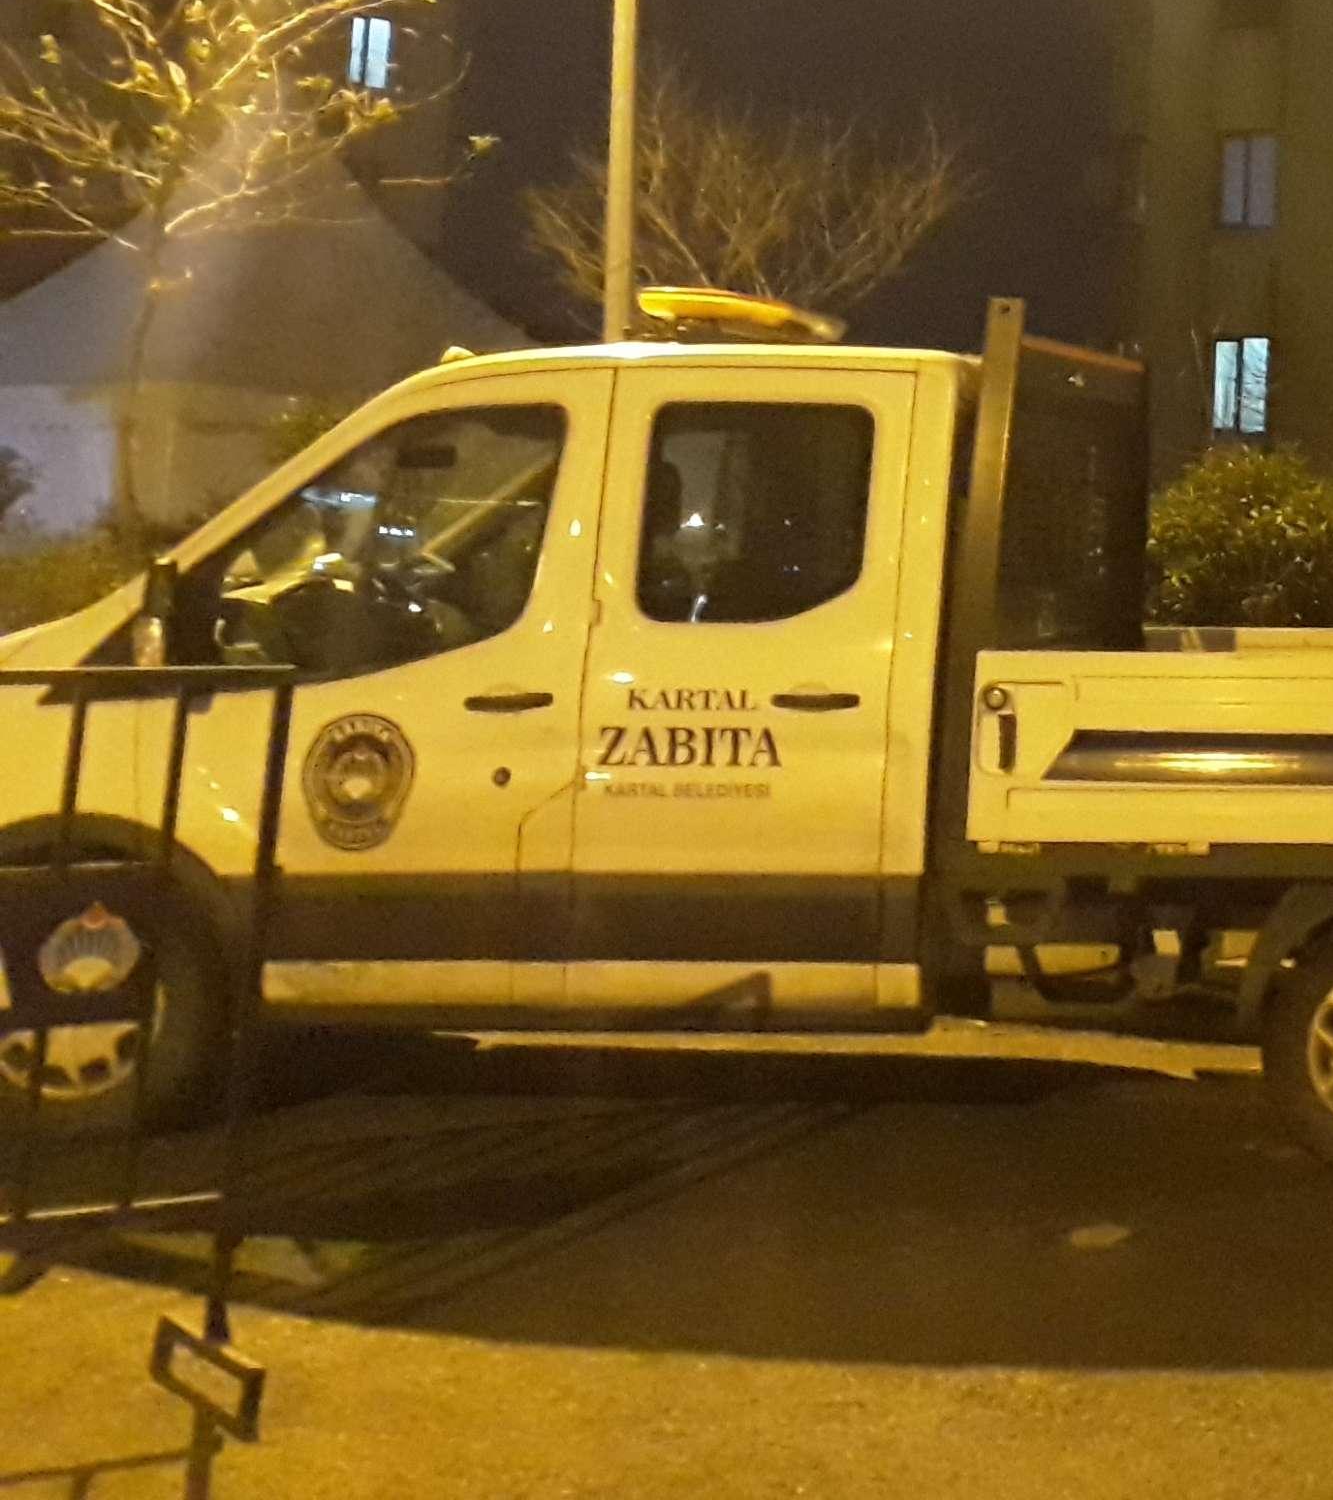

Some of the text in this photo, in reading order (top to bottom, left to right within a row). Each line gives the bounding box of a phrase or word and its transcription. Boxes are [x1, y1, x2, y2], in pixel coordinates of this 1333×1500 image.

[628, 689, 757, 711] KARTAL
[599, 726, 783, 768] ZABITA
[604, 782, 667, 798] KARTAL
